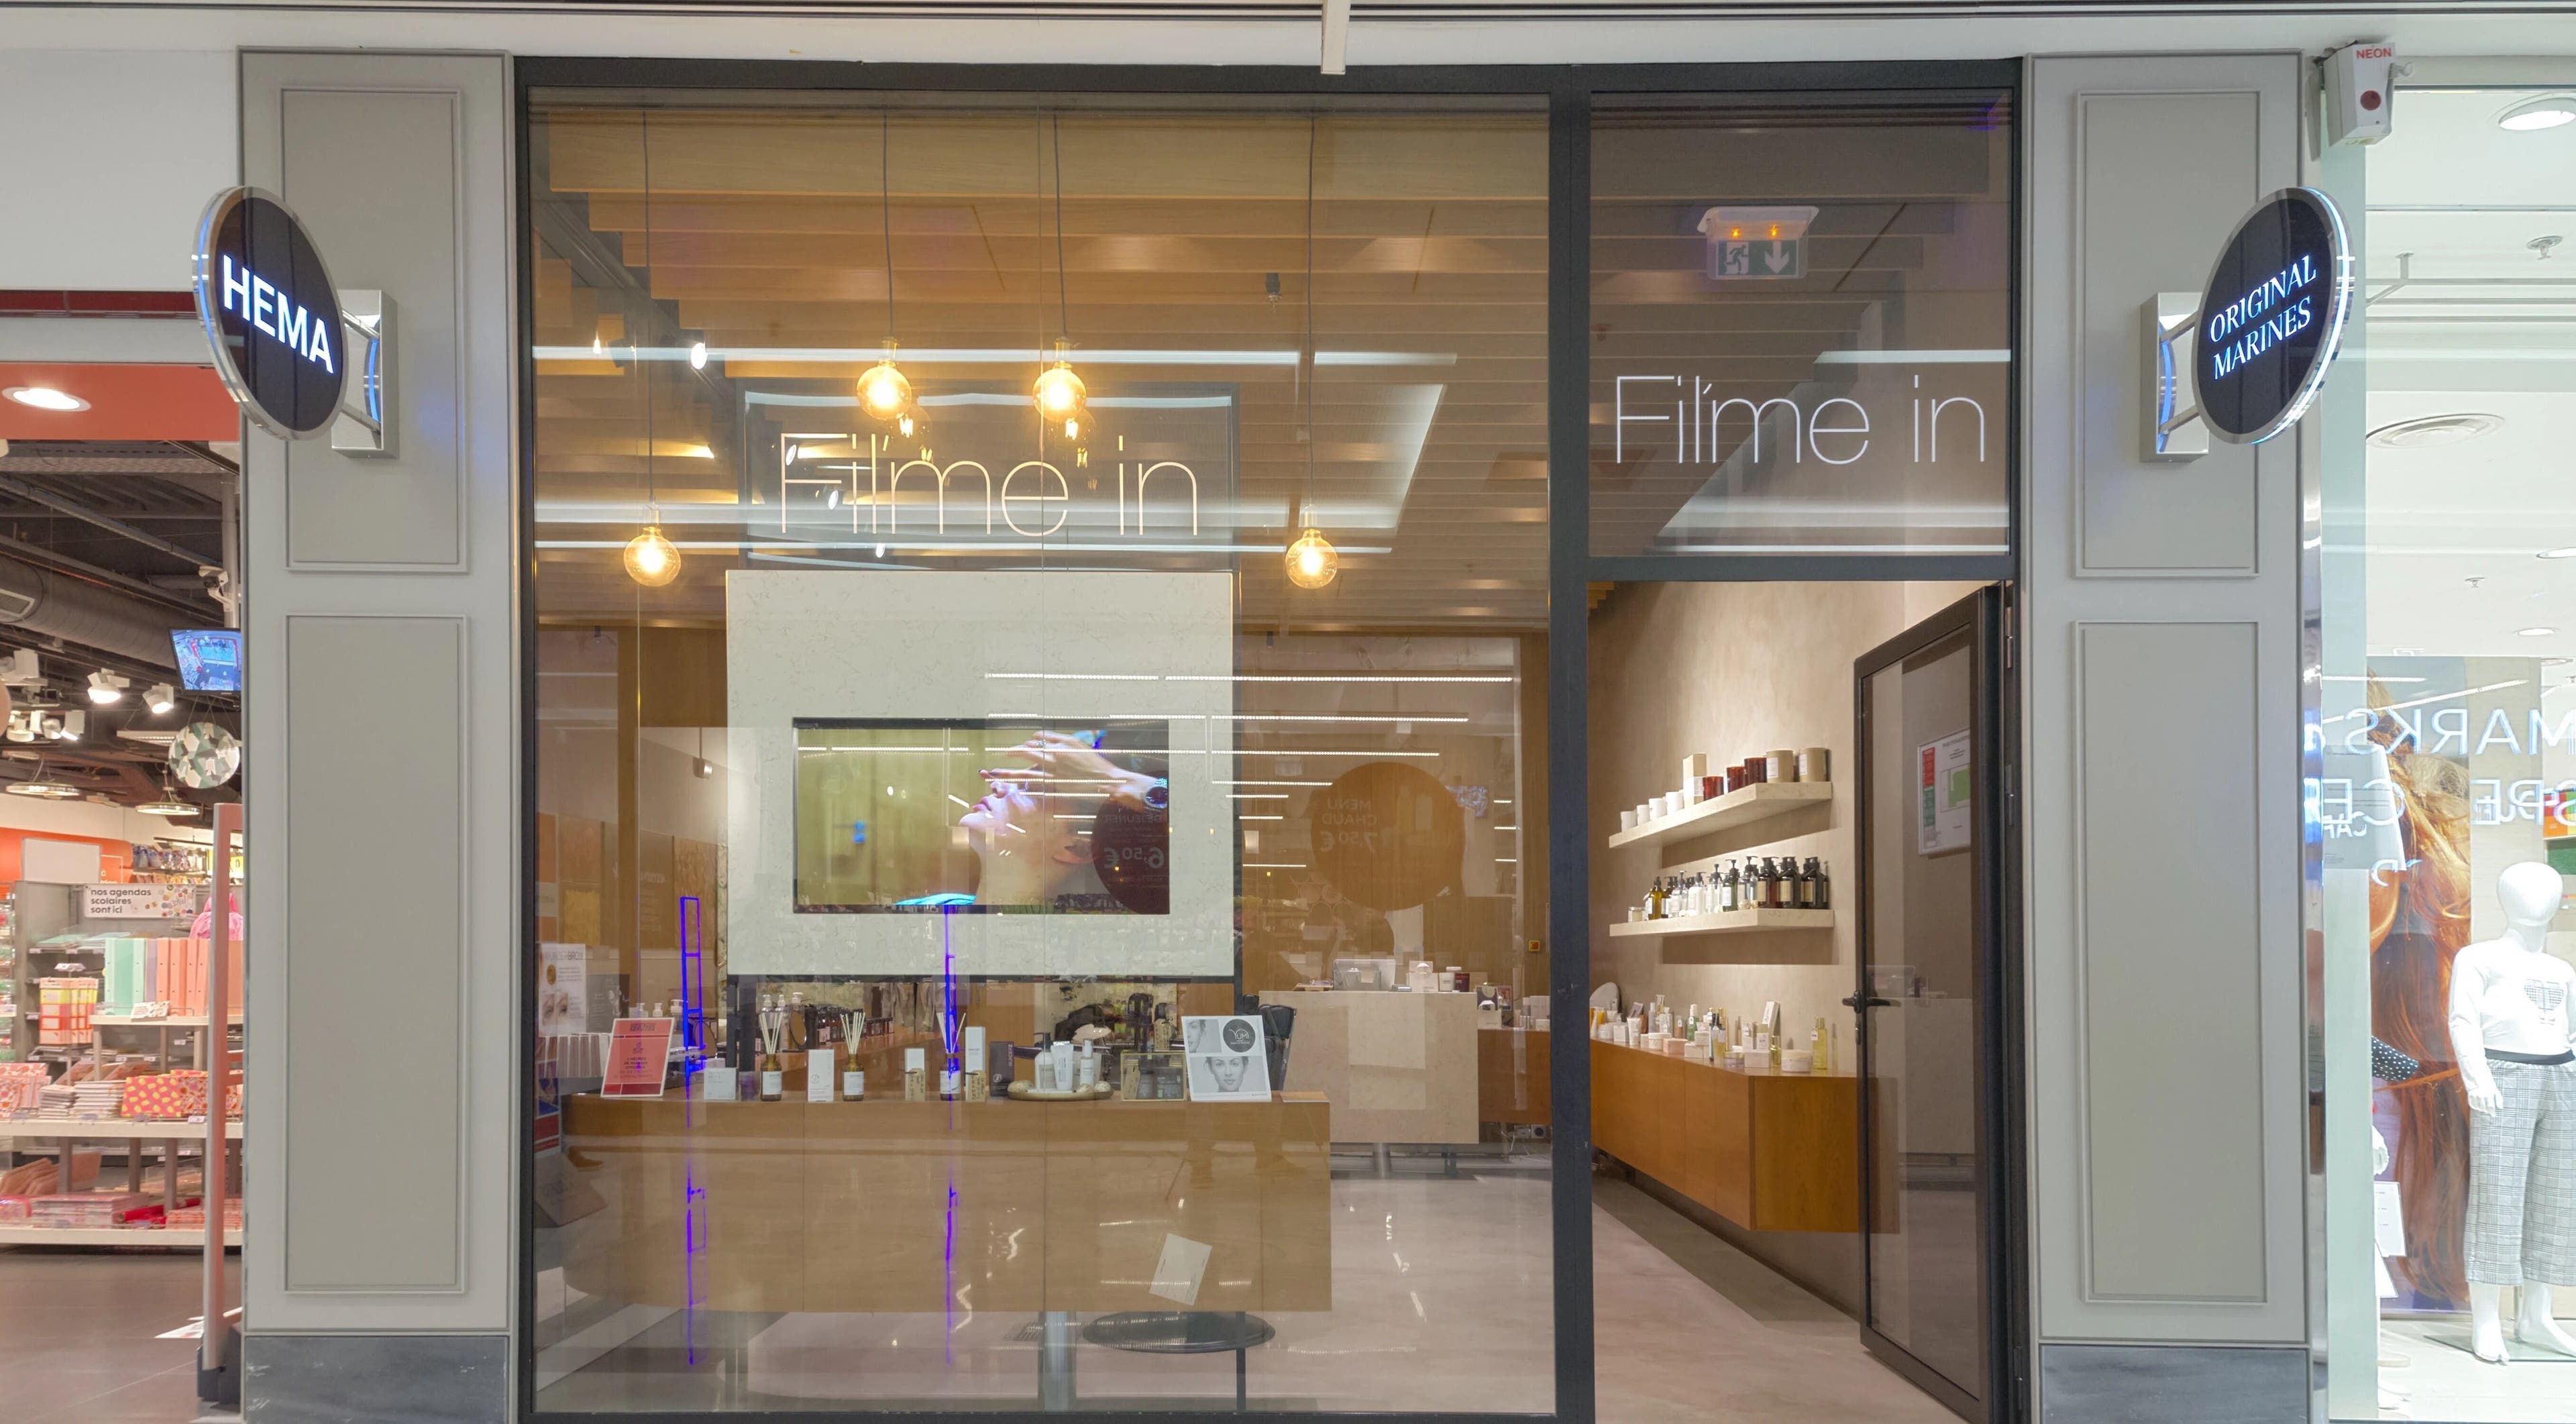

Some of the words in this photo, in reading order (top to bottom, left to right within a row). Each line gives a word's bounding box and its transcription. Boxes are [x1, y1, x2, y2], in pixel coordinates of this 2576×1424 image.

[2356, 48, 2392, 59] NEON
[223, 254, 334, 374] HEMA
[2209, 254, 2317, 343] ORIGINAL
[2213, 296, 2312, 380] MARINES
[1914, 374, 1985, 463] in
[1118, 435, 1198, 536] in
[91, 906, 111, 914] sont
[112, 906, 122, 914] ici
[109, 889, 151, 897] agendas
